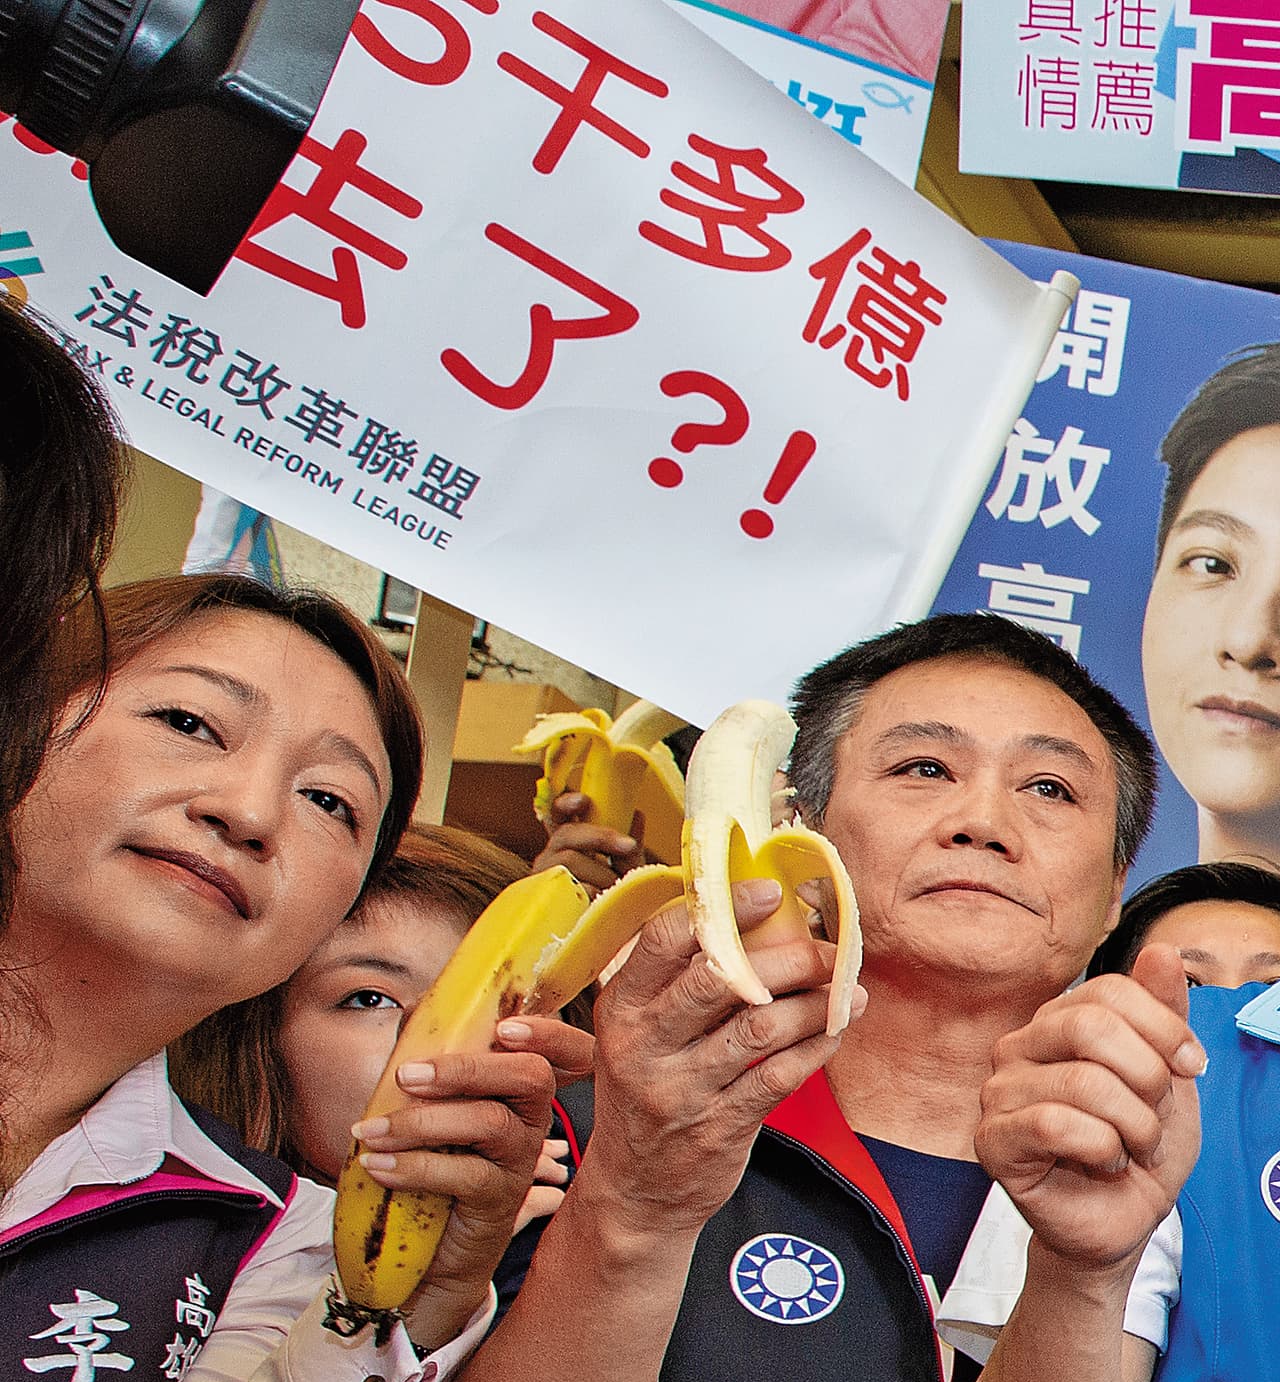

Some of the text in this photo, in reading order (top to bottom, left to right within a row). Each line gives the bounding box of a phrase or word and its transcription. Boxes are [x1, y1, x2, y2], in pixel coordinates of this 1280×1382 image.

[74, 273, 481, 521] 法稅改革聯盟
[114, 366, 135, 389] &
[141, 378, 226, 437] LEGAL
[233, 426, 345, 495] REFORM
[351, 488, 454, 551] LEAGUE
